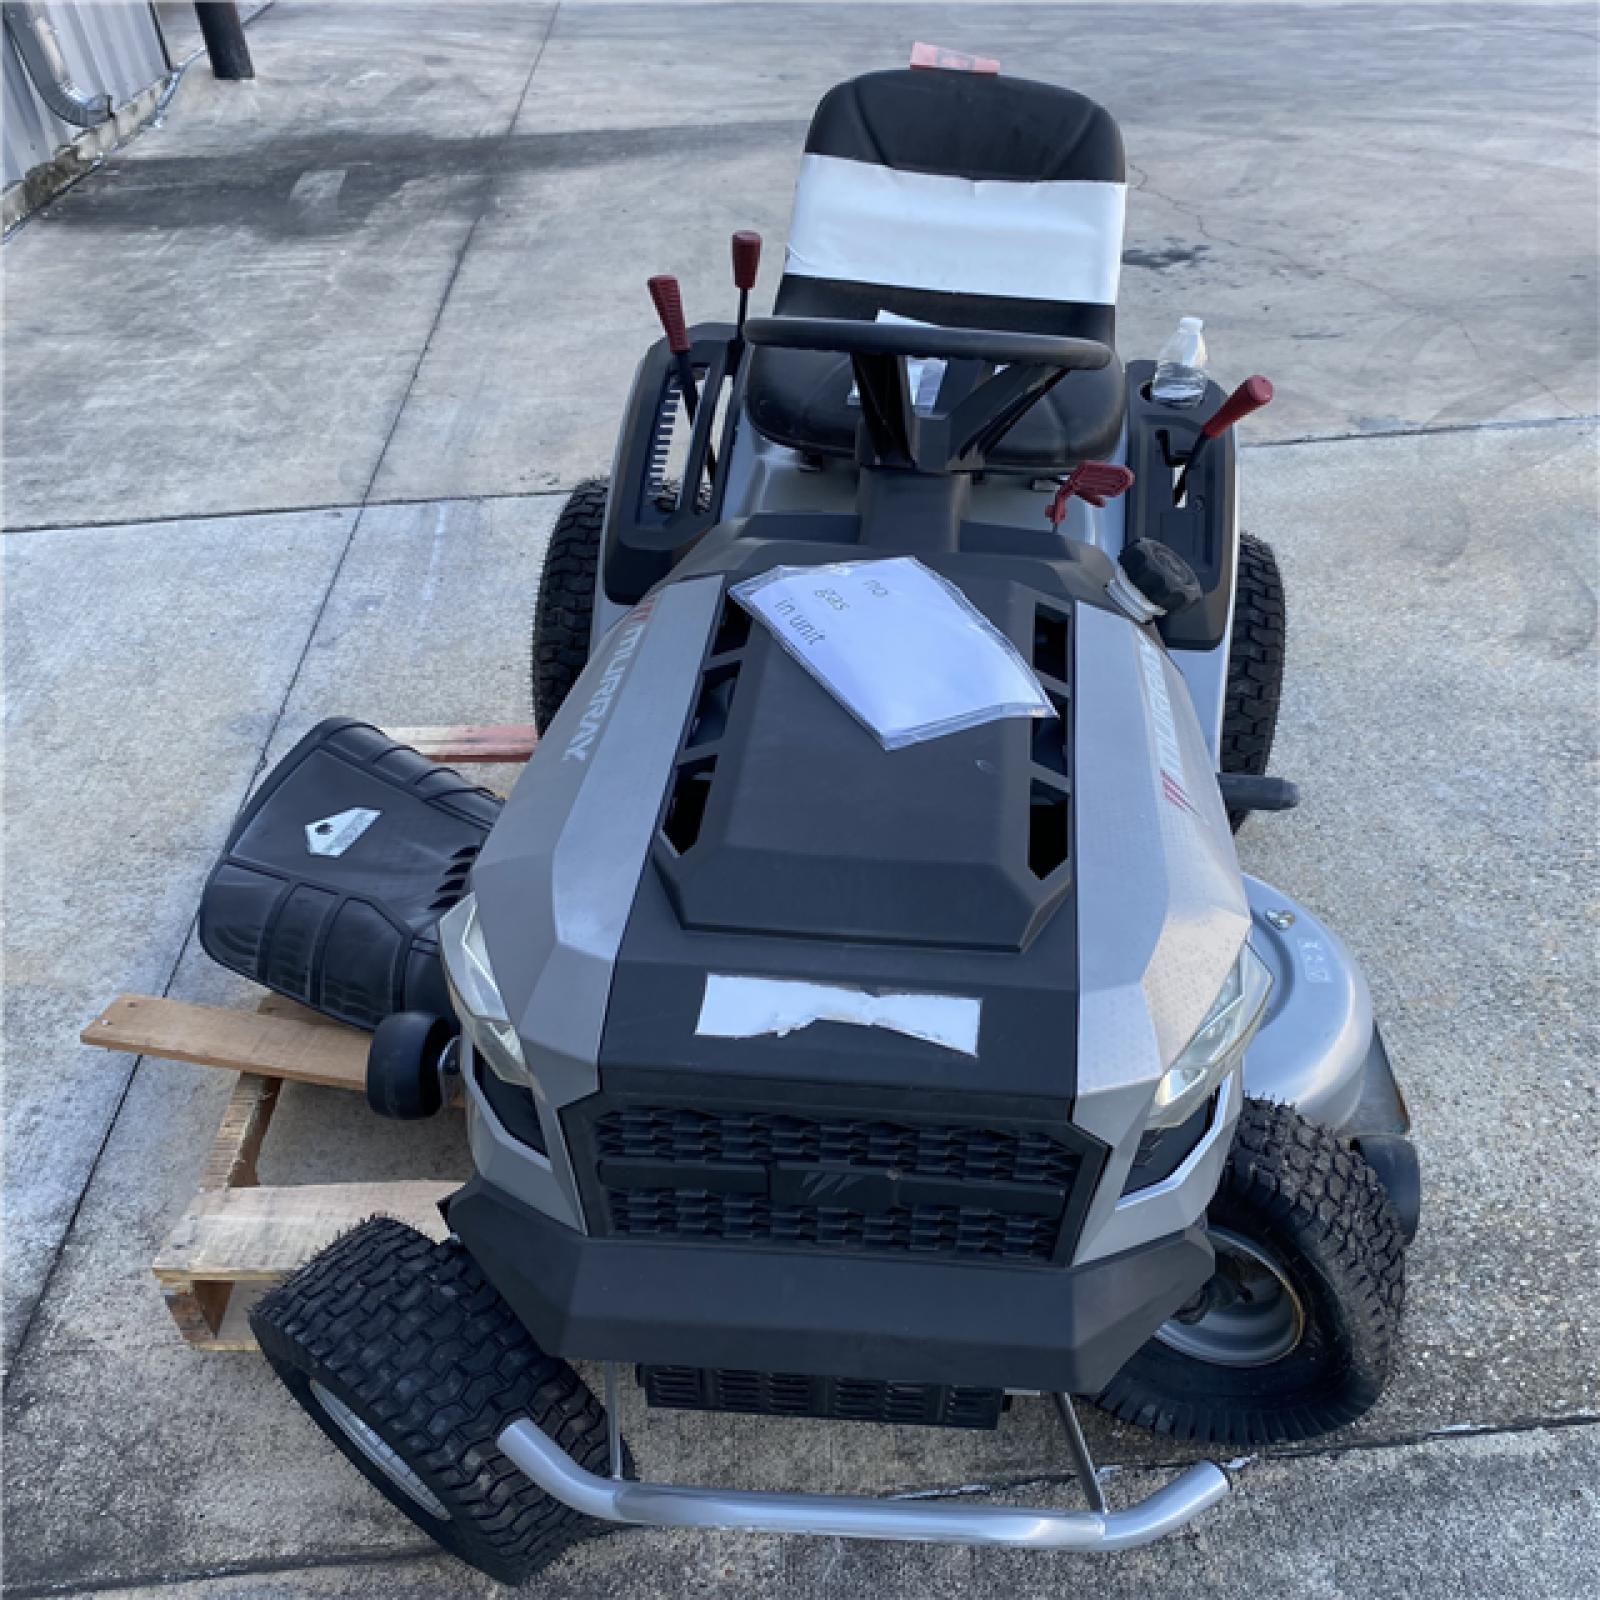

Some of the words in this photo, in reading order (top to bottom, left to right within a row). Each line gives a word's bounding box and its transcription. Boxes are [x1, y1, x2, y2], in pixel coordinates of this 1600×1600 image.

[814, 587, 850, 611] gas
[862, 579, 889, 598] no
[774, 597, 796, 616] in
[789, 614, 826, 646] unit
[562, 622, 645, 761] MURRAY
